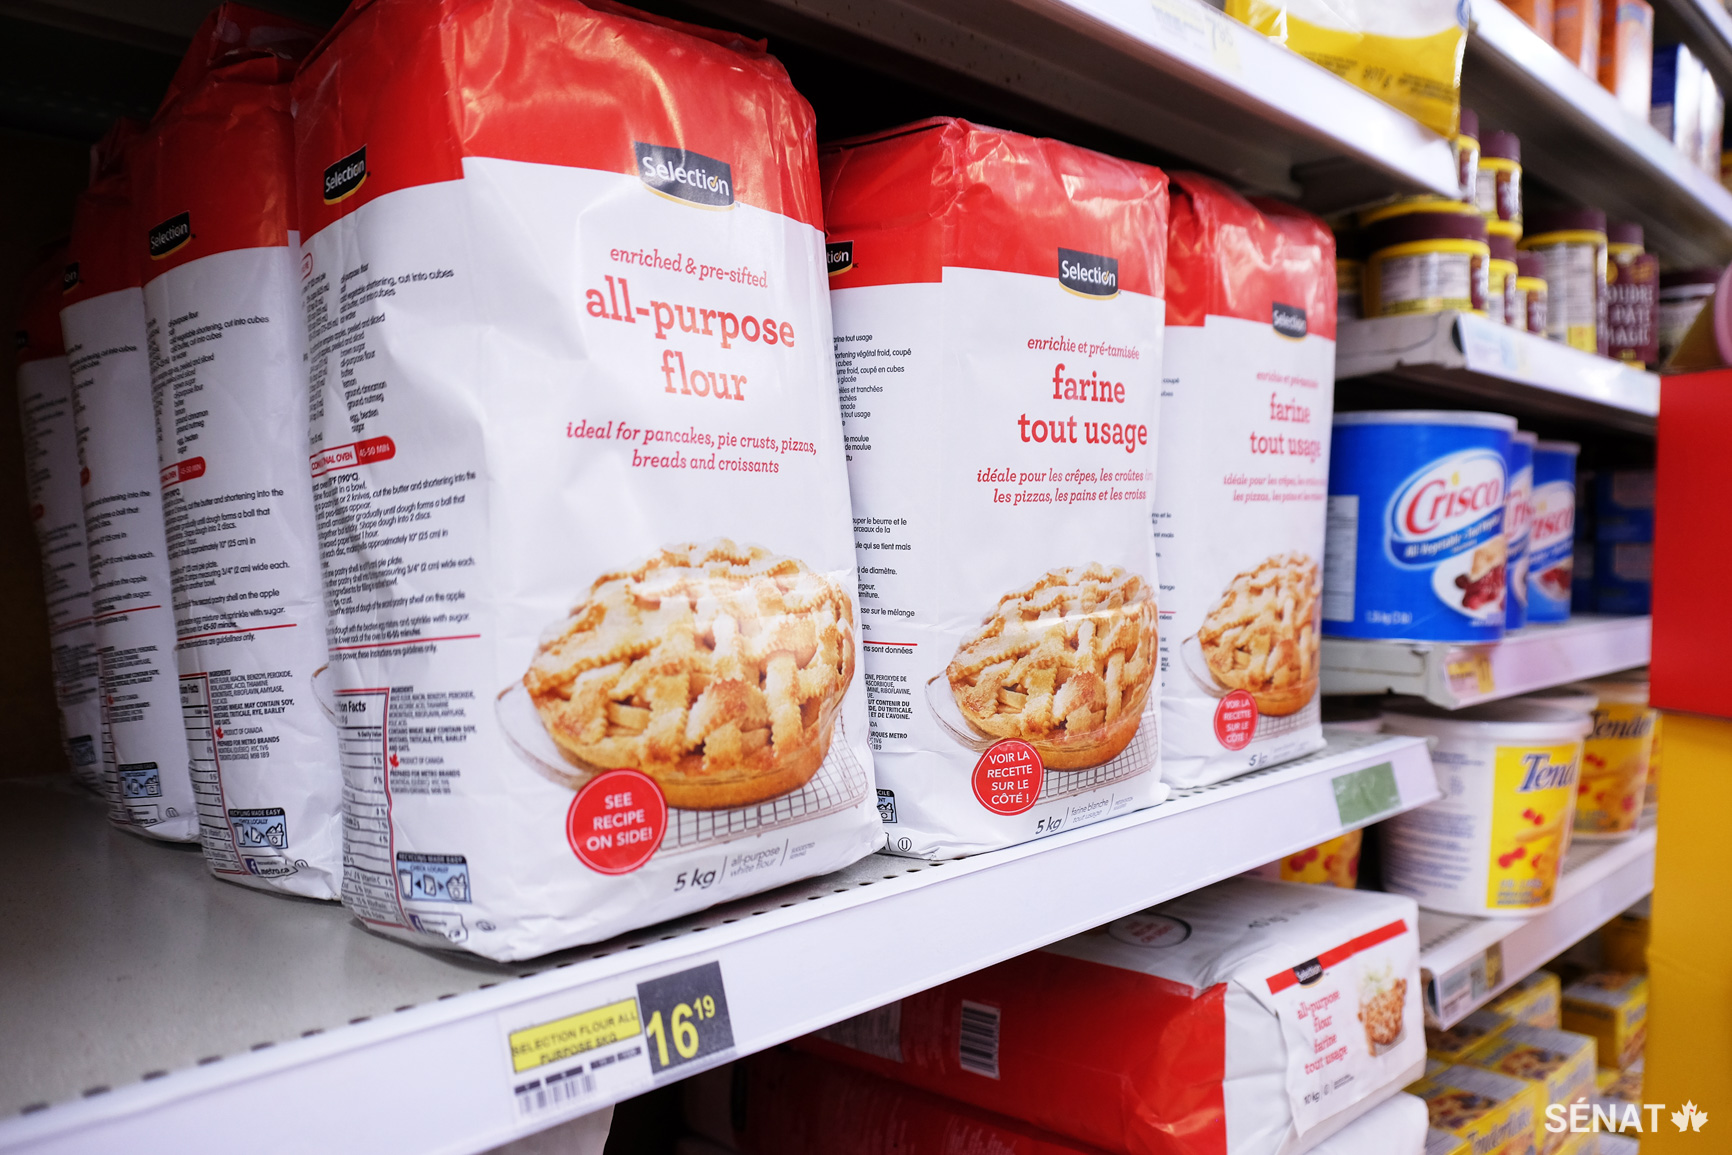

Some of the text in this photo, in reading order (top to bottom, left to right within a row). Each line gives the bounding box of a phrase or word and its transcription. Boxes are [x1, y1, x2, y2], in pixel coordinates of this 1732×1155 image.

[326, 158, 364, 192] Selection
[642, 156, 730, 196] Selection
[150, 222, 188, 250] Selection
[429, 268, 454, 280] cubes
[610, 247, 768, 288] enriched & pre-sifted
[1062, 260, 1116, 288] Selection
[1607, 284, 1654, 304] OUDRE
[586, 274, 795, 350] all-purpose
[1273, 310, 1307, 332] Selection
[892, 348, 912, 358] coupé
[1027, 335, 1140, 360] enrichie et pré-tamisée
[661, 349, 747, 401] flour
[886, 366, 905, 374] cubes
[1052, 363, 1126, 404] farine
[1270, 392, 1311, 424] farine
[566, 418, 817, 456] ideal for pancakes, pie crusts, pizzas,
[1018, 413, 1148, 453] tout usage
[1249, 431, 1322, 464] tout usage
[632, 449, 780, 474] breads and croissants
[976, 467, 1144, 486] idéale pour les crêpes, les croûtes
[1223, 474, 1248, 486] idéale
[271, 488, 284, 497] the
[994, 487, 1148, 506] les pizzas, les pains et les croiss
[1406, 478, 1500, 535] Crisco
[893, 518, 900, 526] et
[900, 518, 908, 526] le
[887, 608, 916, 618] mélange
[884, 646, 914, 656] données
[1226, 698, 1251, 709] VOIR LA
[1223, 710, 1252, 721] RECETTE
[1226, 720, 1250, 732] SUR LE
[888, 732, 908, 740] METRO
[990, 750, 1030, 764] VOIR LA
[1248, 754, 1258, 766] 5
[987, 764, 1032, 778] RECETTE
[1517, 753, 1577, 792] Tend
[992, 779, 1029, 791] SUR LE
[605, 792, 633, 810] SEE
[991, 792, 1023, 805] CÔTÉ
[593, 809, 646, 831] RECIPE
[1036, 819, 1045, 834] 5
[1046, 816, 1062, 832] kg
[1070, 804, 1087, 816] farine
[1087, 798, 1109, 813] blanche
[586, 827, 653, 852] ON SIDE!
[673, 872, 687, 892] 5
[690, 868, 718, 890] kg
[730, 846, 781, 866] all-purpose
[1297, 990, 1340, 1020] all-purpose
[579, 1018, 616, 1037] FLOUR
[618, 1011, 639, 1026] ALL
[1314, 1015, 1332, 1033] flour
[540, 1042, 595, 1066] PURPOSE
[1314, 1034, 1337, 1054] farine
[1304, 1046, 1348, 1075] tout usage
